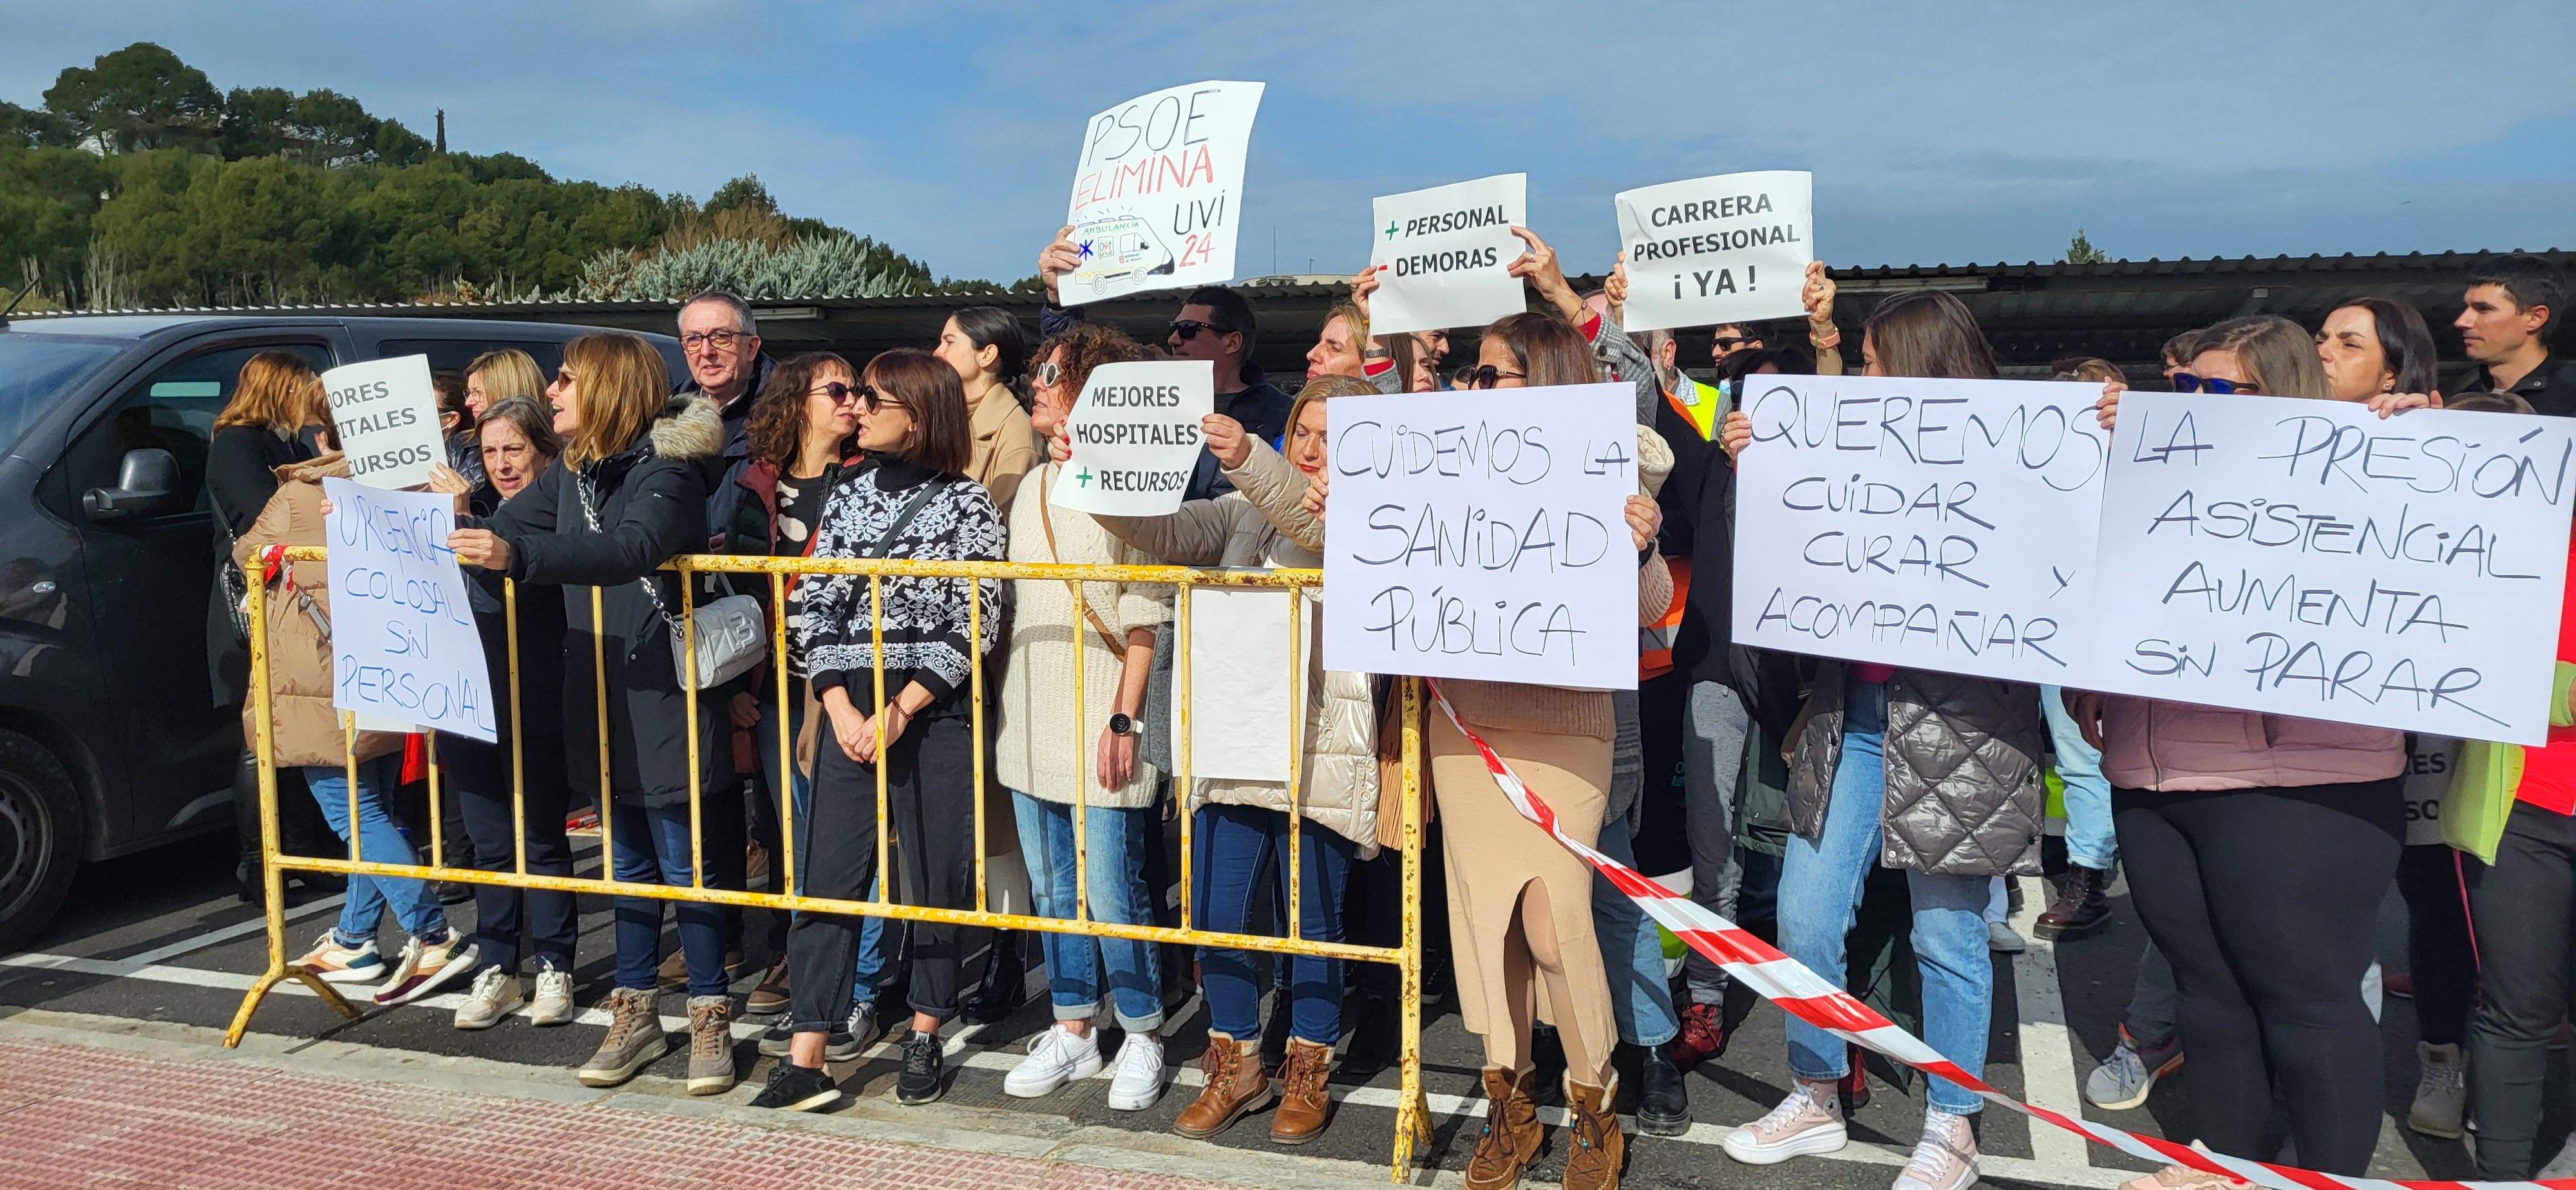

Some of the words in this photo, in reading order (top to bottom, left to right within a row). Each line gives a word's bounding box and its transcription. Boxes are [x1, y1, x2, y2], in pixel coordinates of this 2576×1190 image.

[1087, 89, 1221, 167] PSOE
[1405, 205, 1509, 238] PERSONAL
[1651, 193, 1773, 227] CARRERA
[1179, 232, 1215, 267] 24
[1396, 247, 1497, 277] DEMORAS
[1634, 224, 1801, 261] PROFESIONAL
[1693, 268, 1737, 297] YA
[1092, 386, 1180, 407] MEJORES
[1076, 424, 1198, 445] HOSPITALES
[1750, 386, 2103, 491] QUEREMOS
[2134, 410, 2213, 466] LA
[1584, 439, 1631, 478] LA
[1101, 470, 1188, 491] RECURSOS
[1804, 531, 1989, 589] CURAR
[345, 567, 469, 626] COLOSAL
[2162, 560, 2468, 643] AUMENTA
[1756, 587, 2067, 667] ACOMPAÑAR
[342, 654, 495, 733] PERSONAL
[2244, 632, 2511, 728] PARAR
